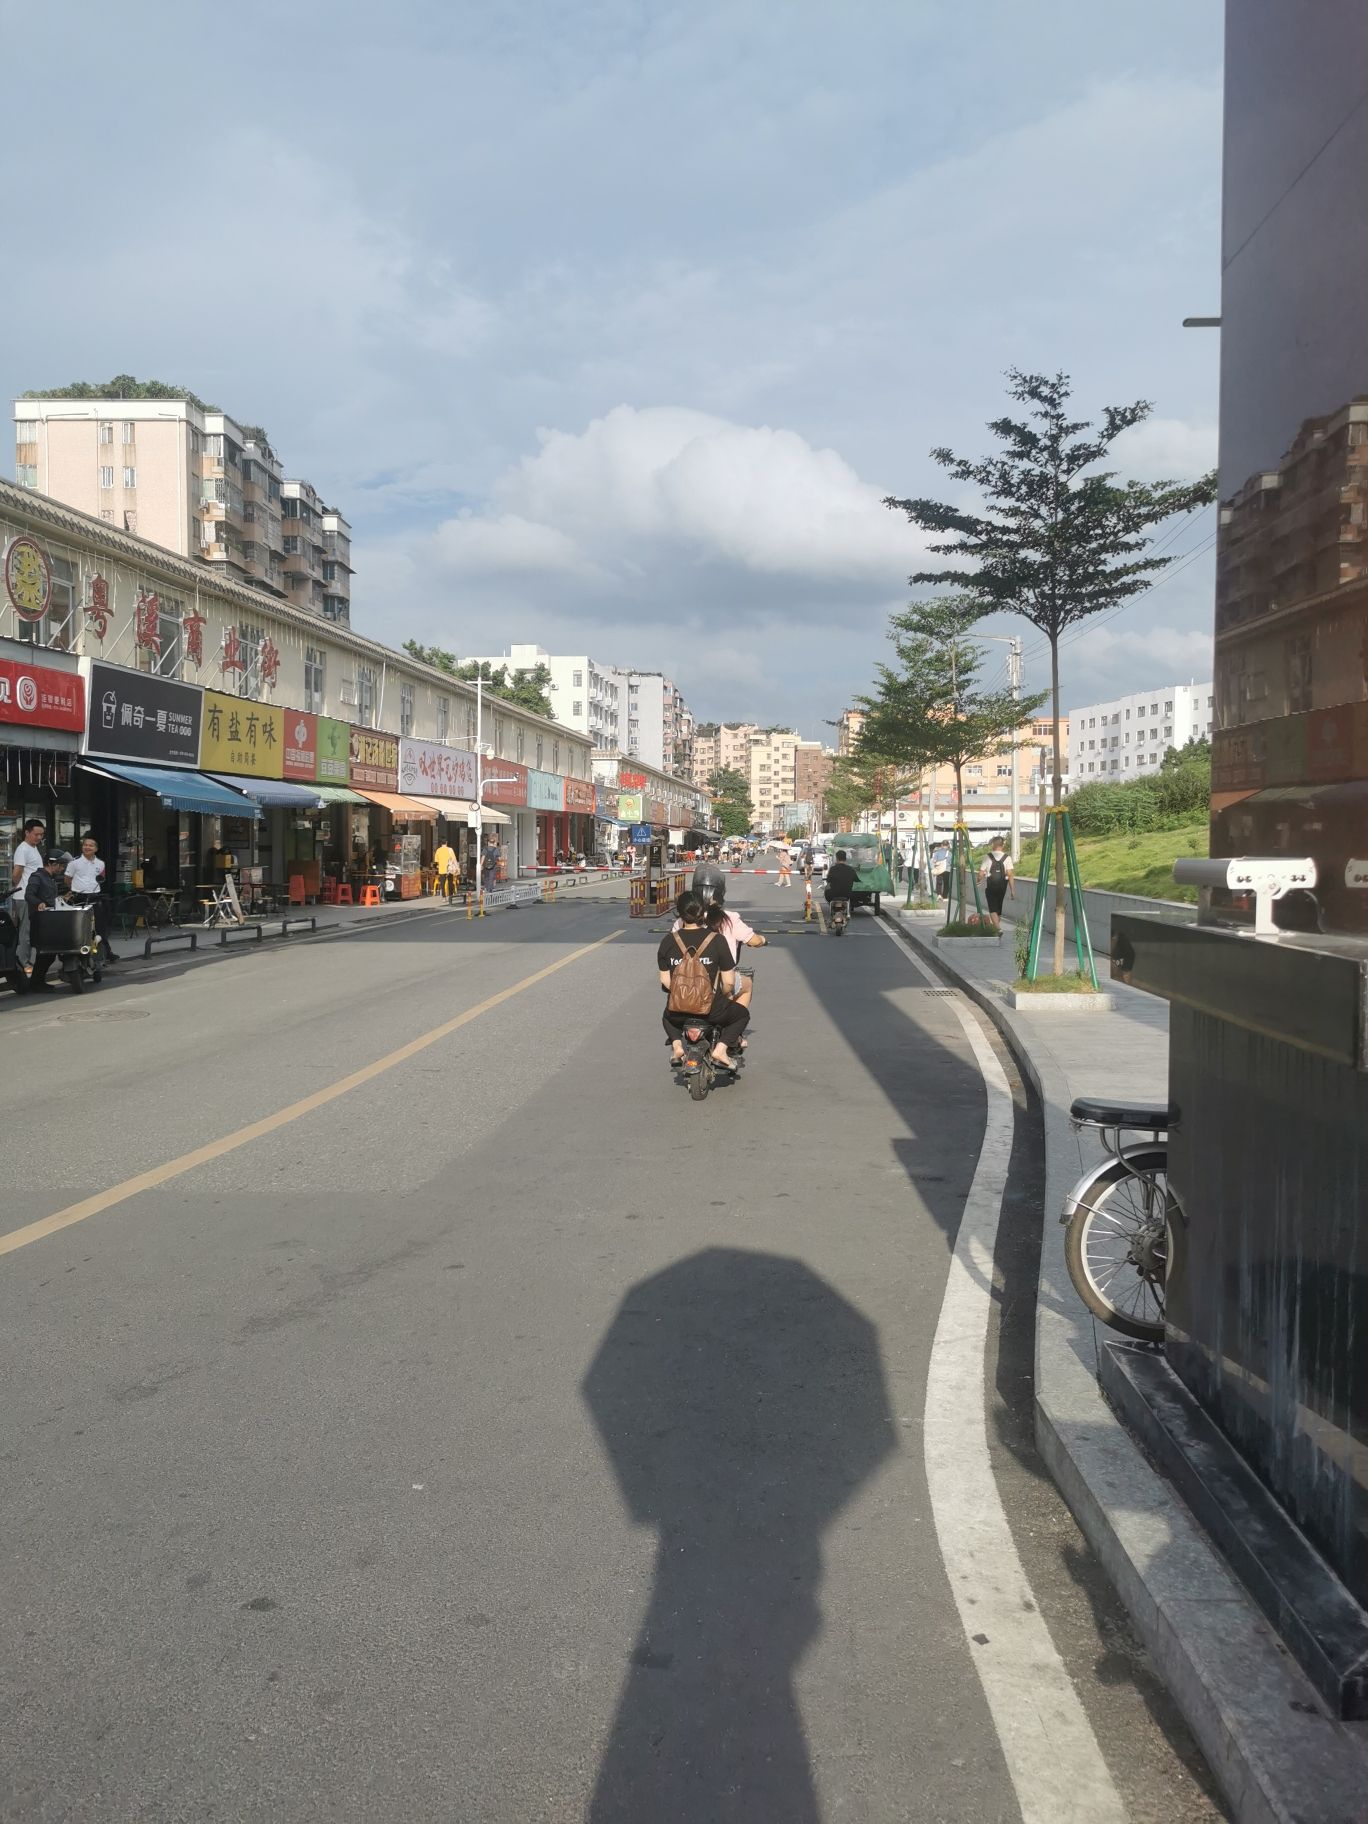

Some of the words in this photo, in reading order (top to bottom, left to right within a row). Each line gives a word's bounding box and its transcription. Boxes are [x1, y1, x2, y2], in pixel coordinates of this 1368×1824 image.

[121, 703, 168, 733] 佩奇一夏
[167, 723, 179, 734] TEA
[168, 712, 193, 726] SUMMER
[208, 703, 277, 750] 有盐有味
